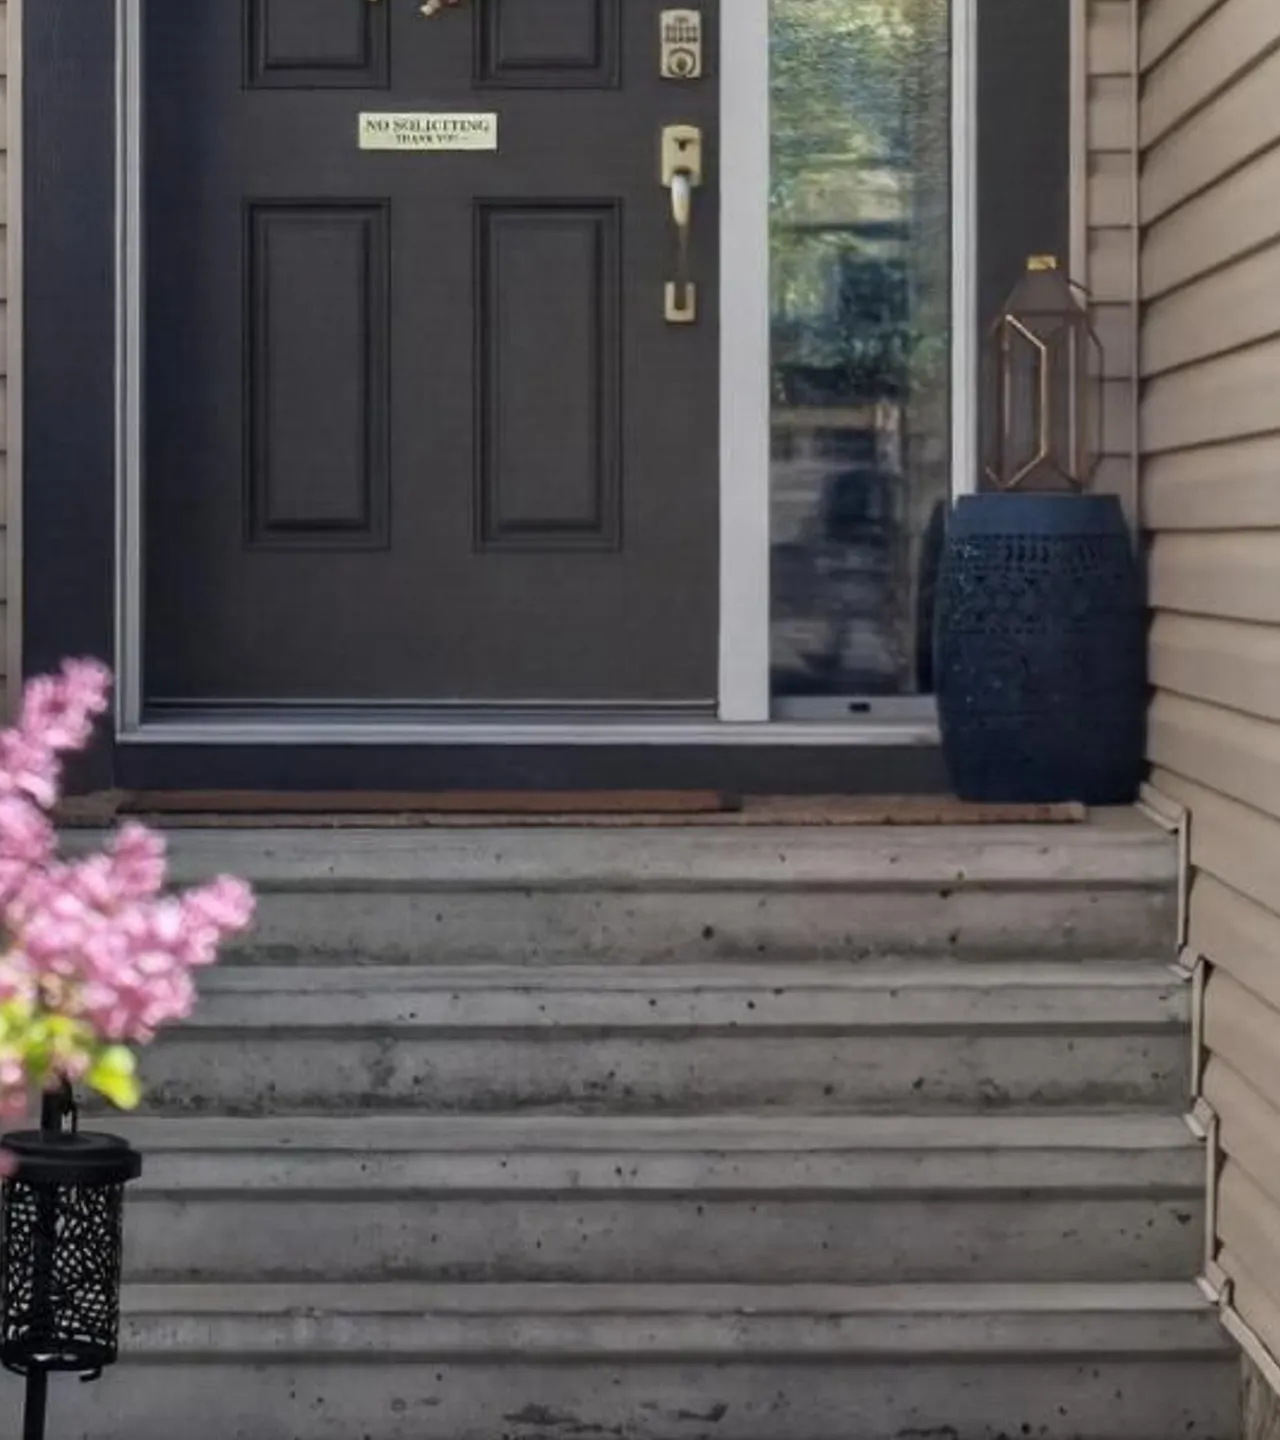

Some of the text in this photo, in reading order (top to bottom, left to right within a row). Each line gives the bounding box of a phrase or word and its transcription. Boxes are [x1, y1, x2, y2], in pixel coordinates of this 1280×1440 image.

[366, 119, 489, 132] NO SOLICITING
[396, 134, 433, 144] THANK
